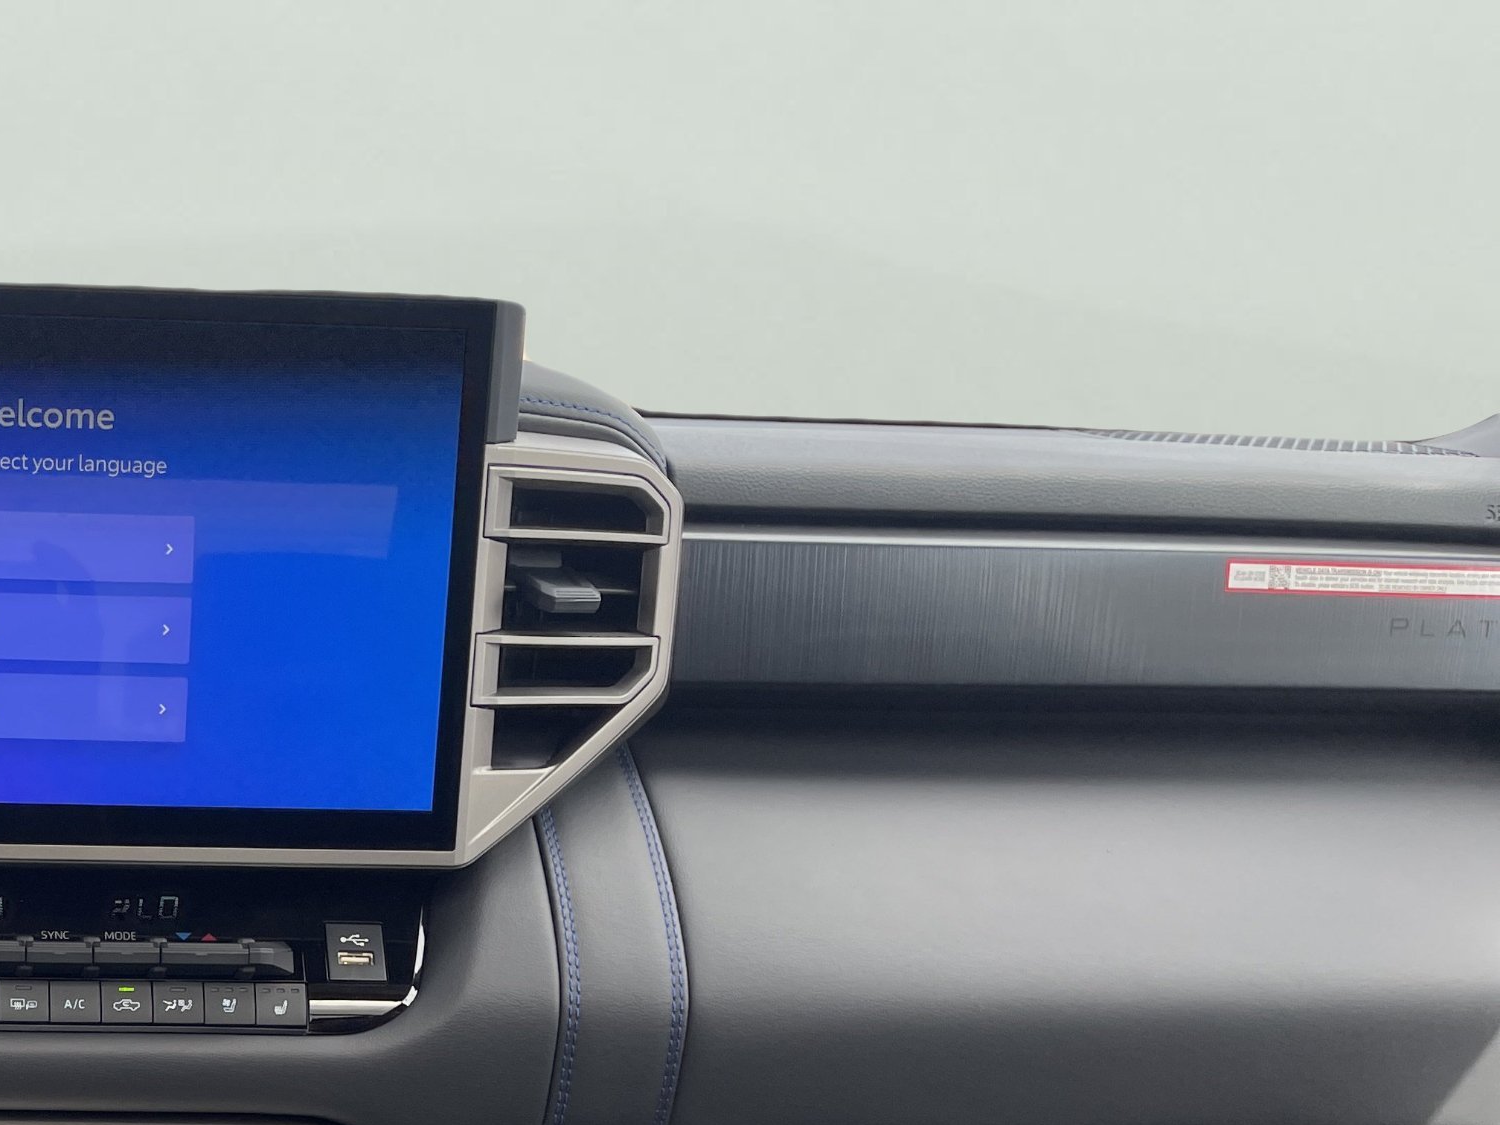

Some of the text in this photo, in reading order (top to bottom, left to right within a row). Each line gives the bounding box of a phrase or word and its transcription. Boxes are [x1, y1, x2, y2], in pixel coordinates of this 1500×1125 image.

[32, 457, 74, 475] your
[78, 454, 168, 478] language
[40, 930, 70, 940] SYNC
[104, 931, 137, 941] MODE
[63, 998, 86, 1010] A/C
